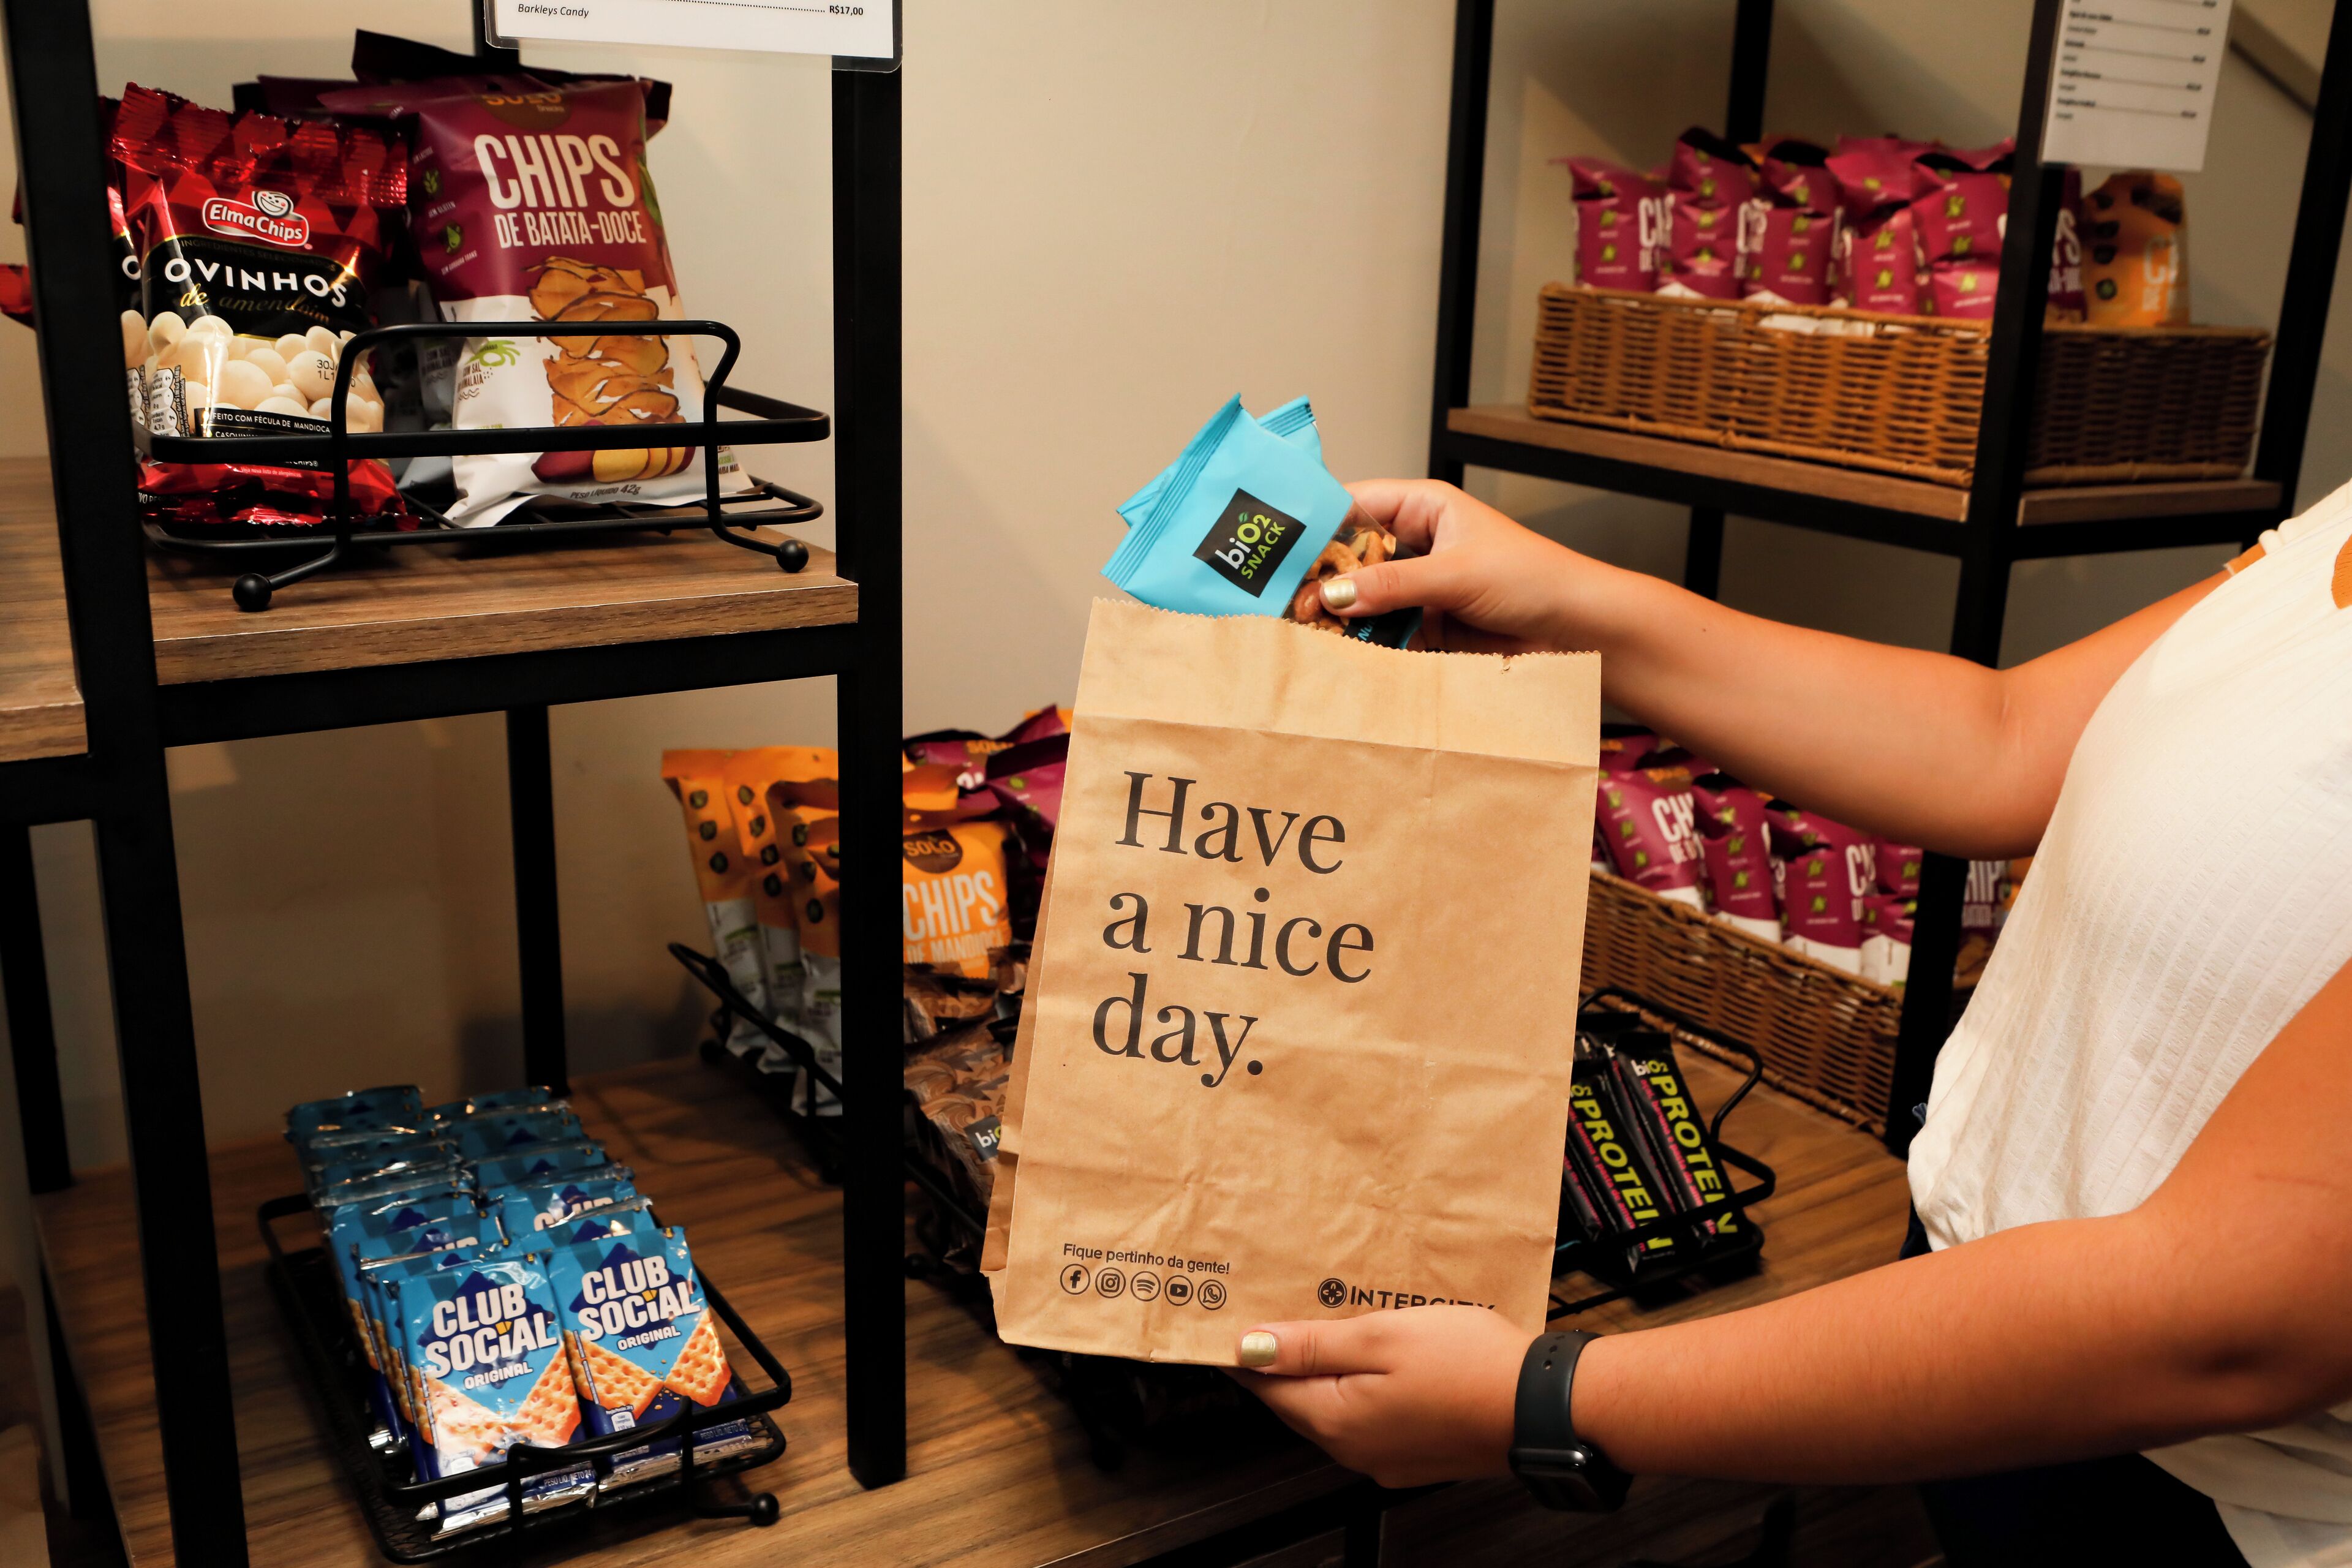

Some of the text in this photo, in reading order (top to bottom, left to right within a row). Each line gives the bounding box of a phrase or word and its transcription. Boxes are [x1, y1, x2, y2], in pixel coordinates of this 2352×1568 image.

[518, 4, 589, 18] Barkleys Candy
[829, 5, 864, 16] R$17,00
[474, 134, 635, 209] CHIPS
[494, 211, 646, 249] DE BATATA-DOCE
[165, 257, 347, 307] OVINHOS
[179, 283, 209, 307] de
[294, 422, 330, 433] MANDIOCA
[620, 484, 641, 495] 42g
[1241, 522, 1285, 579] SNACK
[1115, 771, 1346, 874] Have
[903, 840, 956, 856] SOLO
[903, 870, 1000, 941] CHIPS
[1102, 887, 1374, 983] a nice
[1093, 971, 1264, 1088] day.
[1063, 1243, 1230, 1275] Fique pertinho da gente!
[581, 1256, 669, 1304] CLUB
[433, 1283, 526, 1338] CLUB
[617, 1325, 681, 1351] ORIGINAL
[464, 1362, 533, 1389] ORIGINAL
[544, 1479, 558, 1487] PESO
